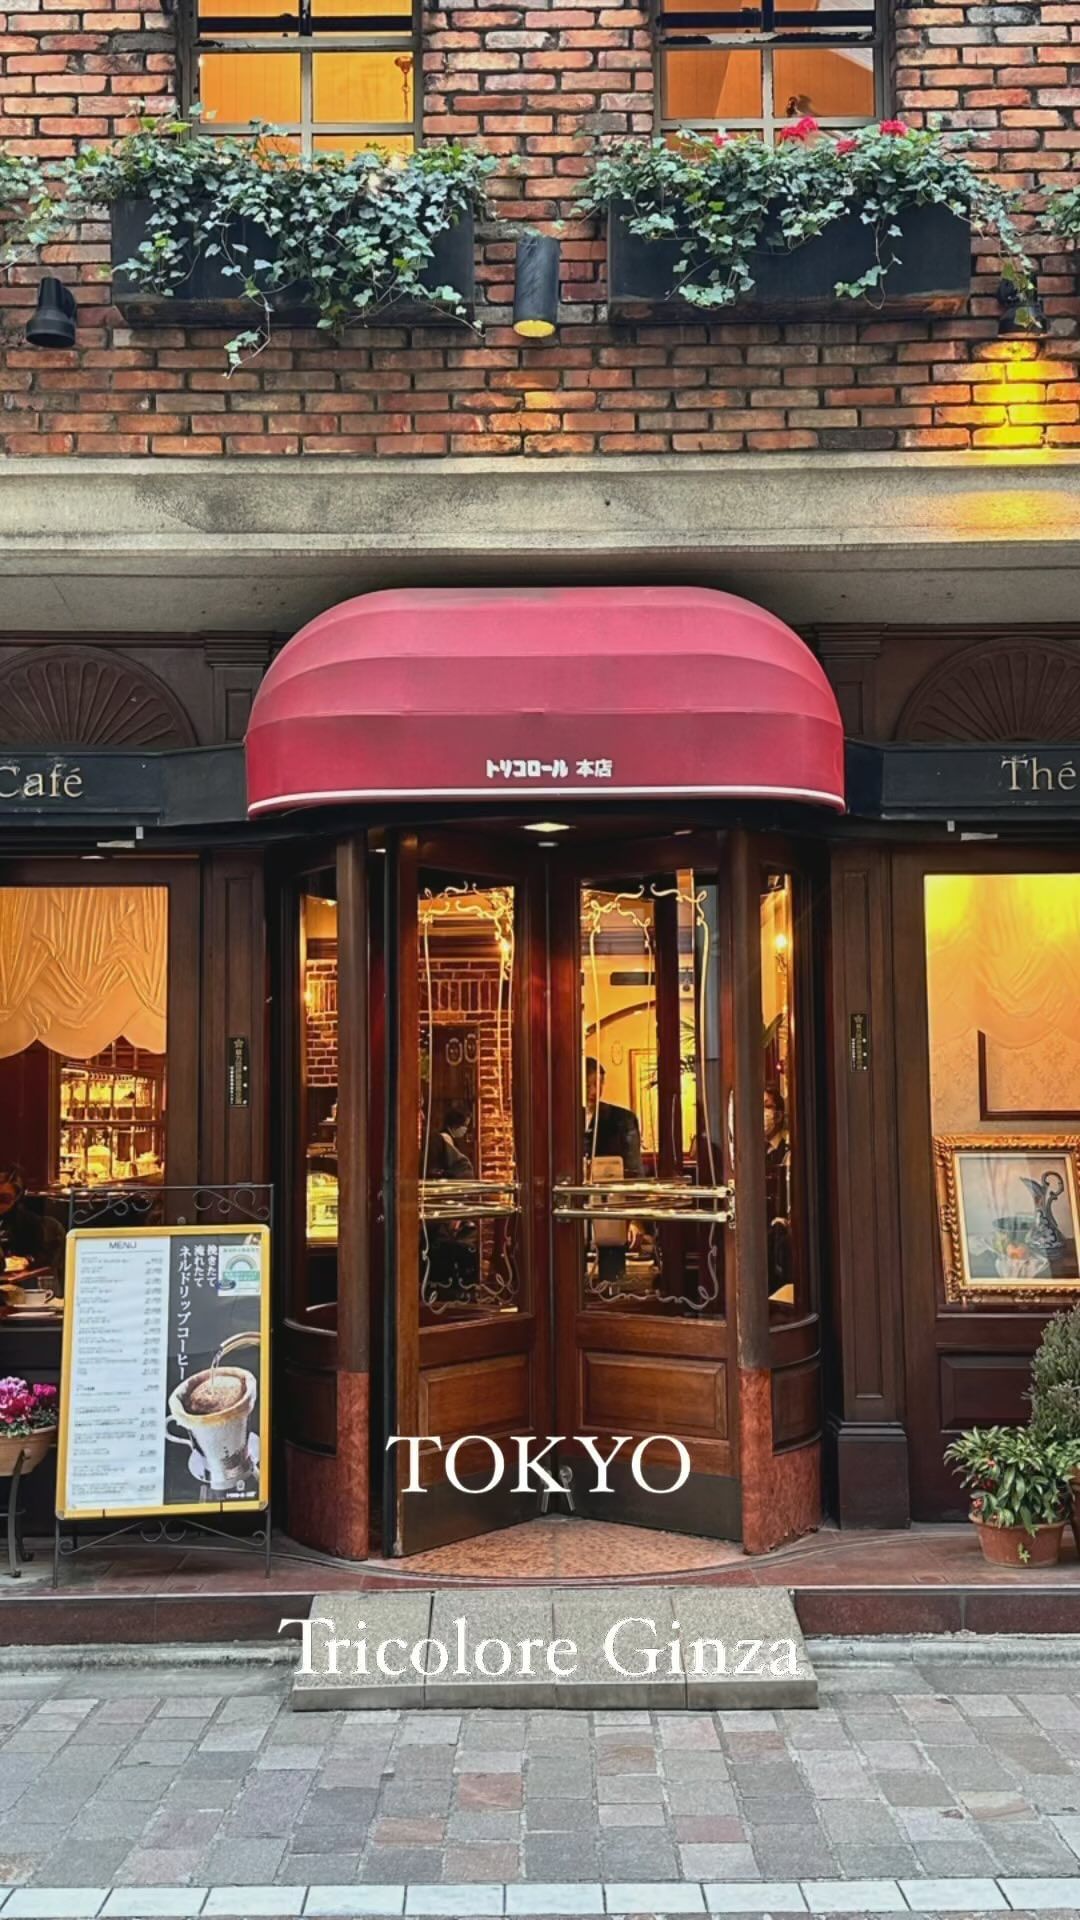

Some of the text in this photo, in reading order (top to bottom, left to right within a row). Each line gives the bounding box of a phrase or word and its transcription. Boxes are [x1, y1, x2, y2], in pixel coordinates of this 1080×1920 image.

[0, 764, 84, 798] Café
[486, 759, 613, 778] トリコロール 本店
[1001, 756, 1077, 790] Thé
[109, 1241, 137, 1249] MENU
[177, 1245, 192, 1381] ネルドリップコーヒー
